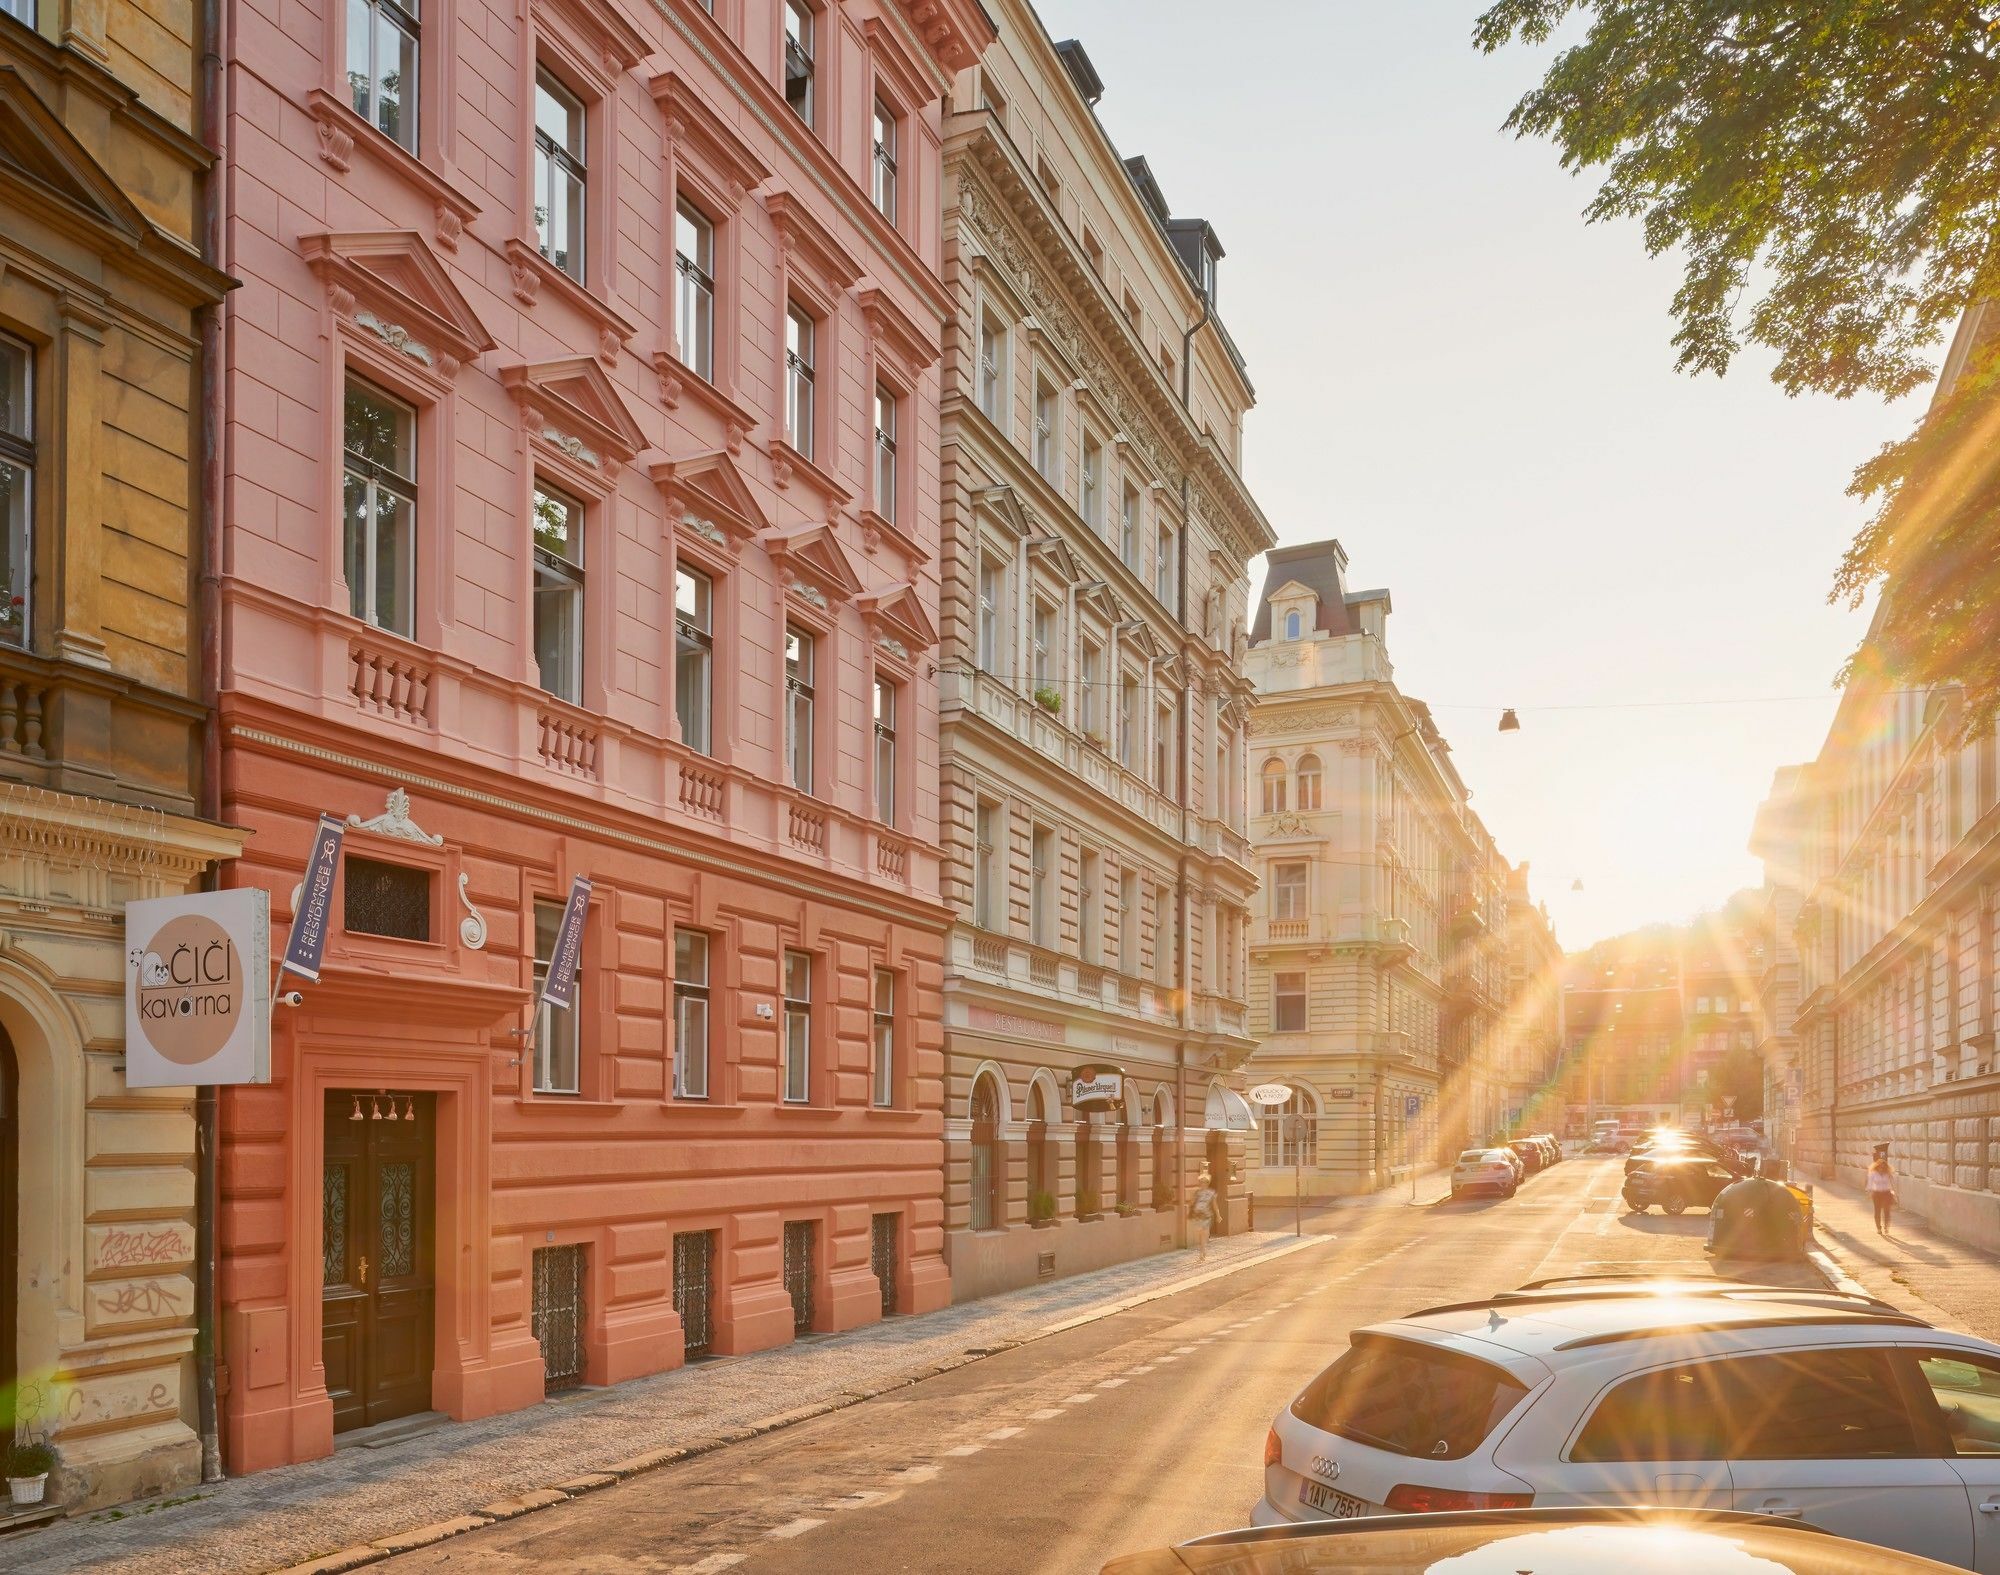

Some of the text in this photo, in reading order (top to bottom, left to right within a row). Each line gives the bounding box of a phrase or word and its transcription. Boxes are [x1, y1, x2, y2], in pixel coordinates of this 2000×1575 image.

[301, 865, 327, 944] REMEMBER
[308, 867, 332, 947] RESIDENCE
[556, 916, 577, 980] REMEMBER
[562, 917, 582, 982] RESIDENCE
[993, 1013, 1054, 1041] RESTAURANT
[1408, 1098, 1417, 1110] P
[1309, 1485, 1361, 1518] 1AV 7551
